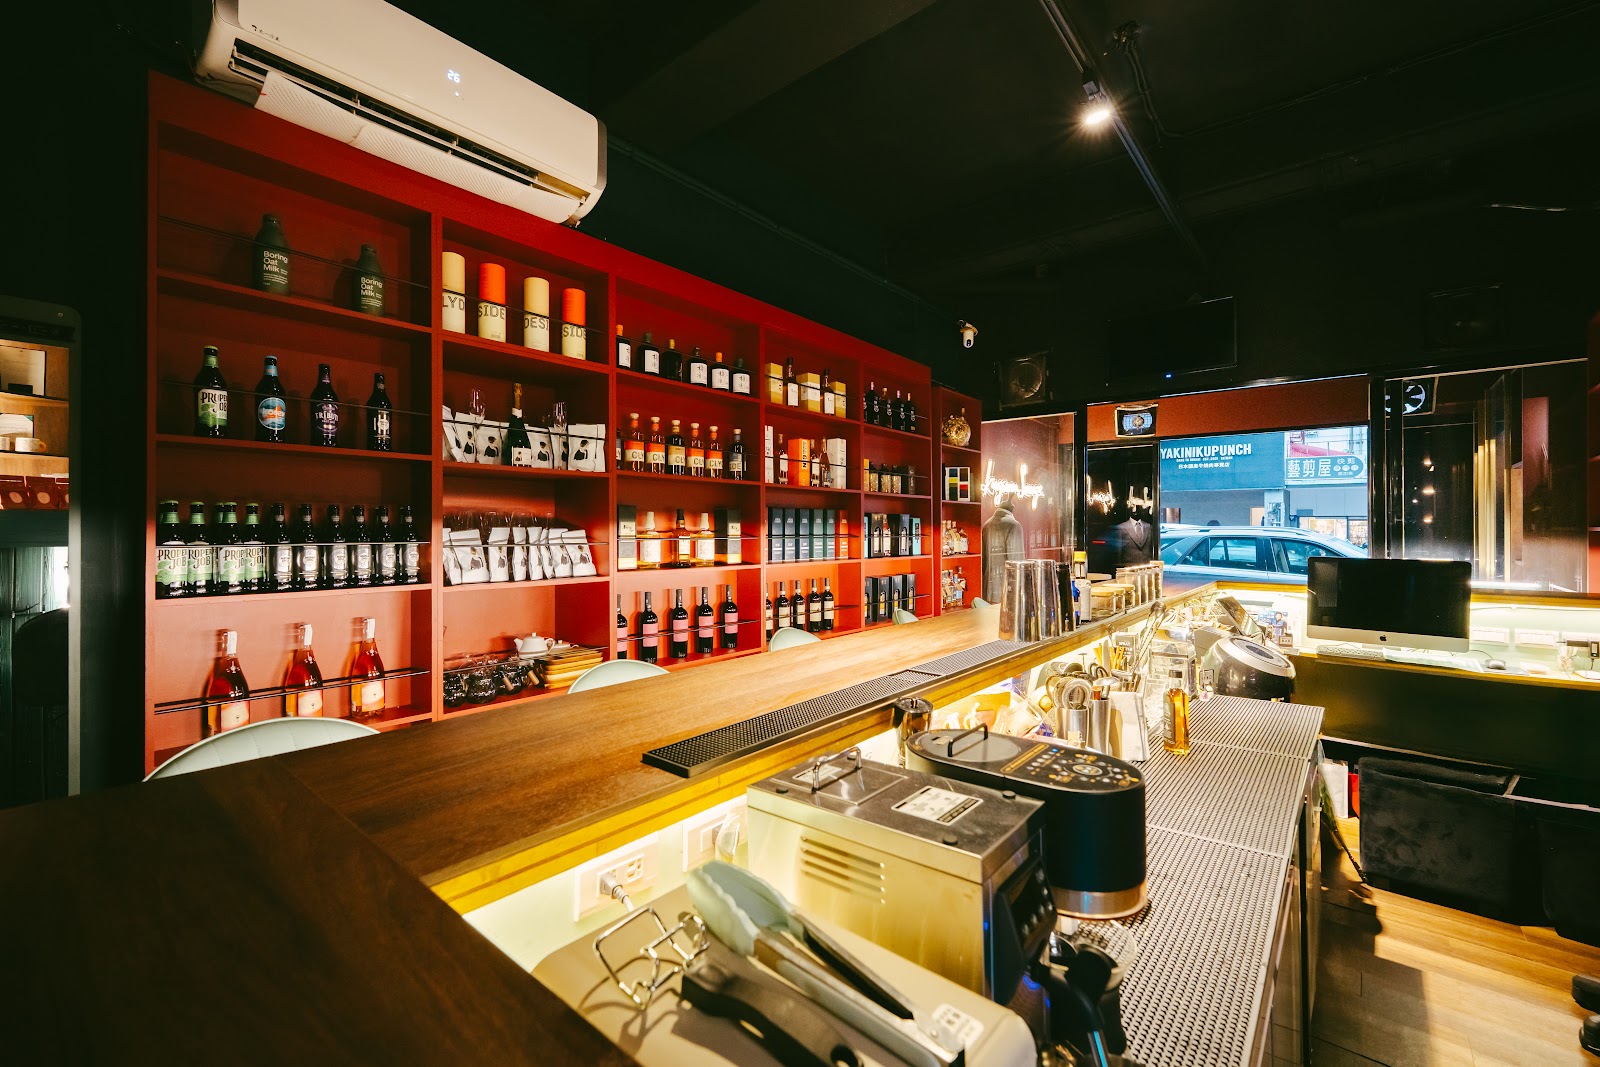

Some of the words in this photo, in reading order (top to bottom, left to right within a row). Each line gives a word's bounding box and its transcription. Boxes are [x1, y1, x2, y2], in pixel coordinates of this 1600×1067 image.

[447, 69, 461, 83] 26
[263, 250, 288, 263] Boring
[263, 258, 278, 266] Oat
[263, 264, 280, 273] Milk
[361, 276, 383, 289] Boring
[361, 289, 375, 297] Milk
[1160, 443, 1252, 460] YAKINIKUPUNCH
[1287, 458, 1331, 478] 藝剪屋
[169, 556, 187, 570] JOB
[193, 555, 211, 569] JOB
